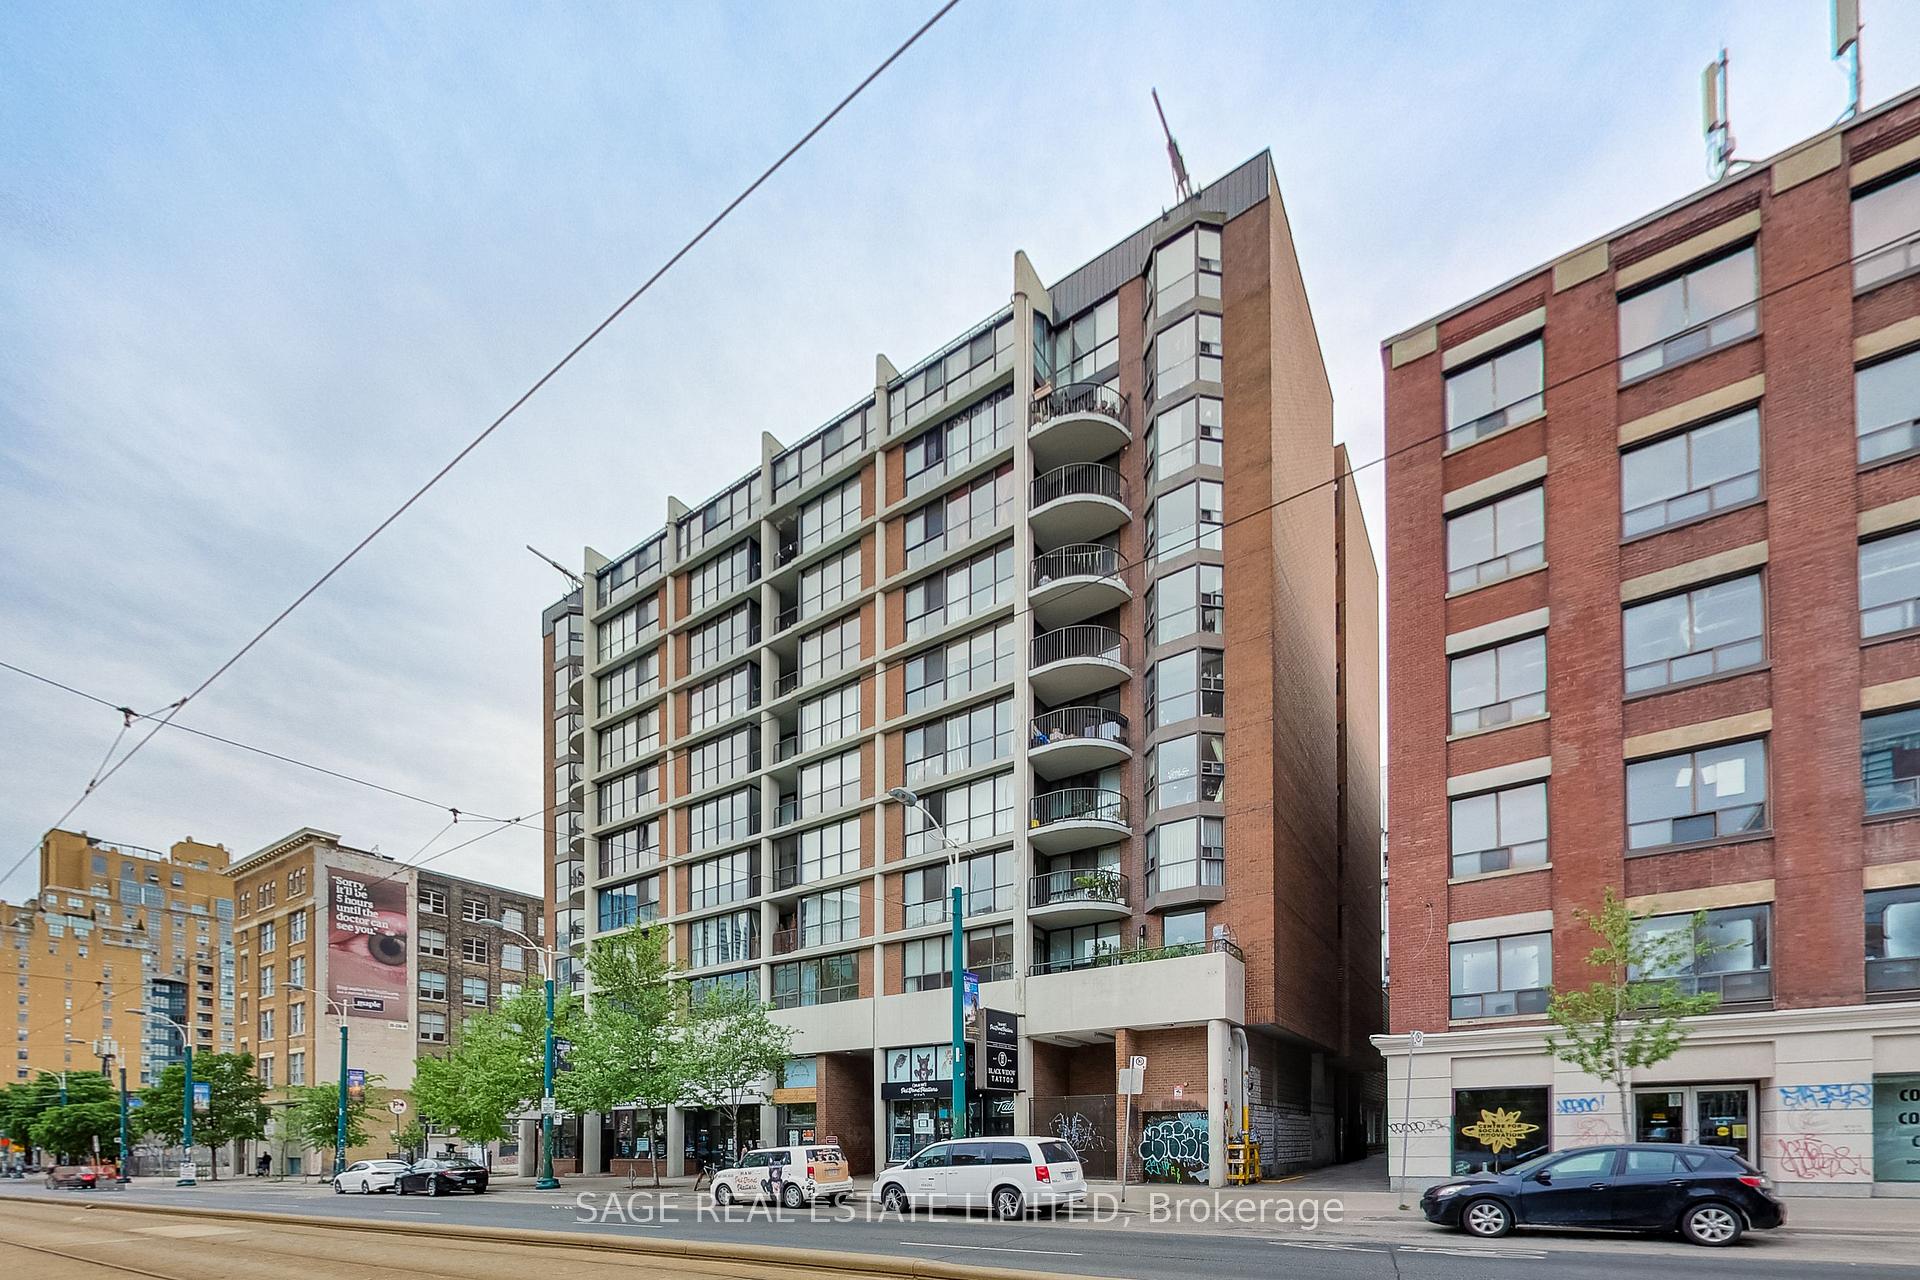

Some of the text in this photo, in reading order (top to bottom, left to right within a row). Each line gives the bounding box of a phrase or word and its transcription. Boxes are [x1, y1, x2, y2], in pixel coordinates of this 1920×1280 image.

[336, 885, 368, 899] It'll be
[336, 894, 374, 909] 5 hours
[336, 904, 379, 918] until the
[336, 913, 389, 929] doctor can
[336, 922, 353, 931] see
[357, 1000, 381, 1008] maple
[988, 1067, 1001, 1075] BLACK
[991, 1075, 1014, 1083] TATTOO
